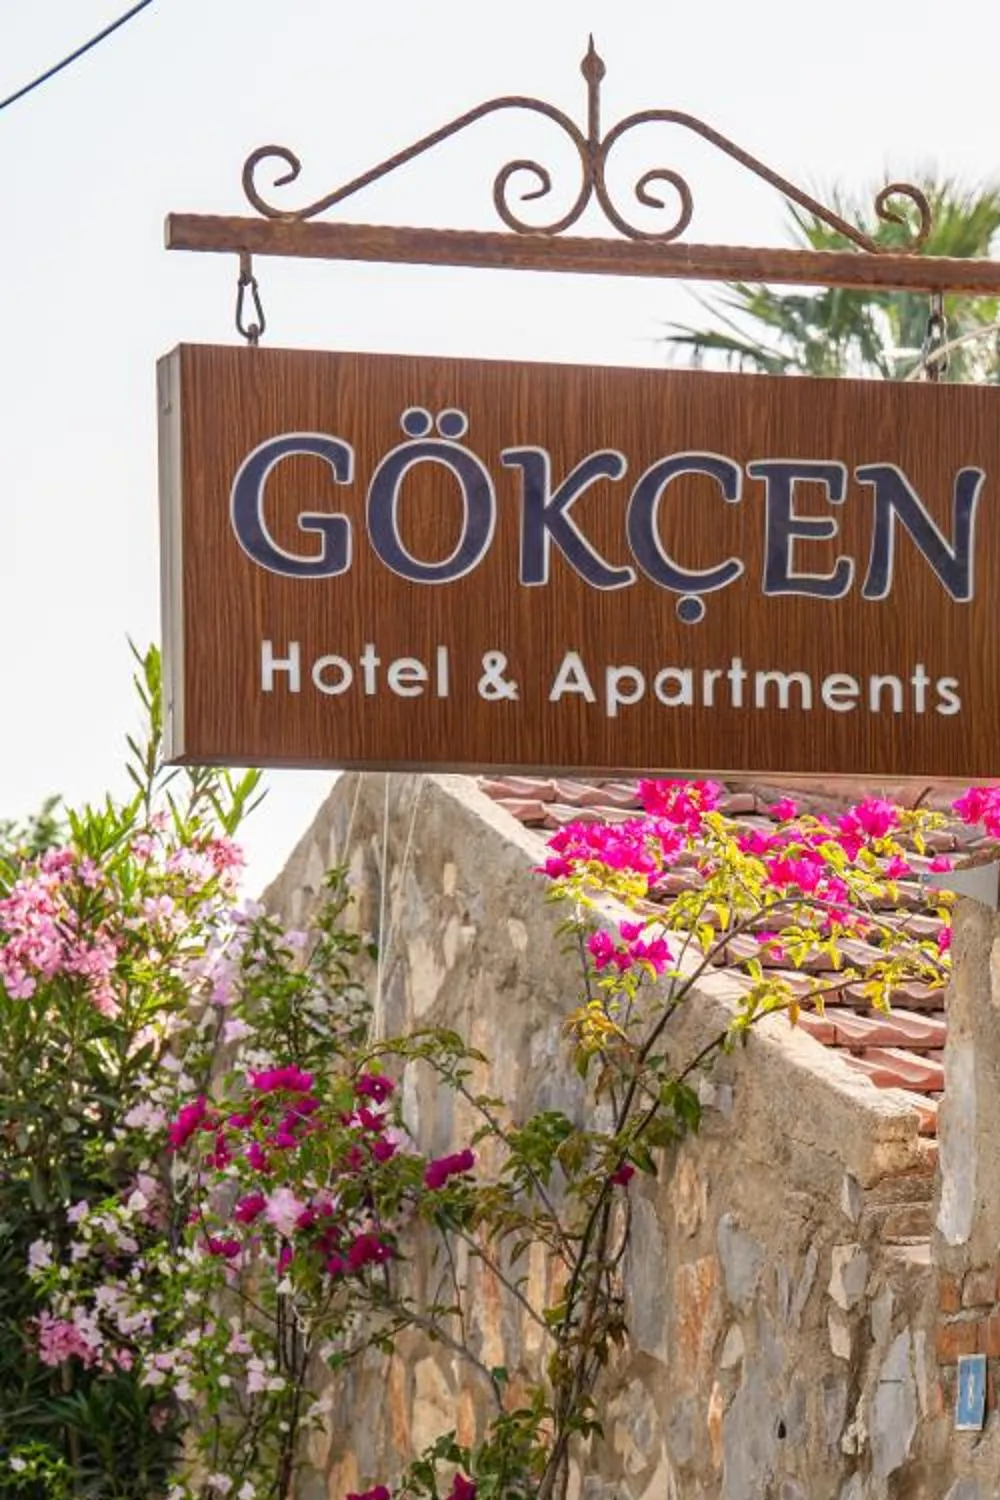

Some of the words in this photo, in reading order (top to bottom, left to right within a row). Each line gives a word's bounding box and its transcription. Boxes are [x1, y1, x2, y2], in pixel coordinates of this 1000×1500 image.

[229, 406, 986, 624] GÖKÇEN
[260, 639, 451, 699] Hotel
[477, 650, 519, 702] &
[549, 651, 962, 718] Apartments
